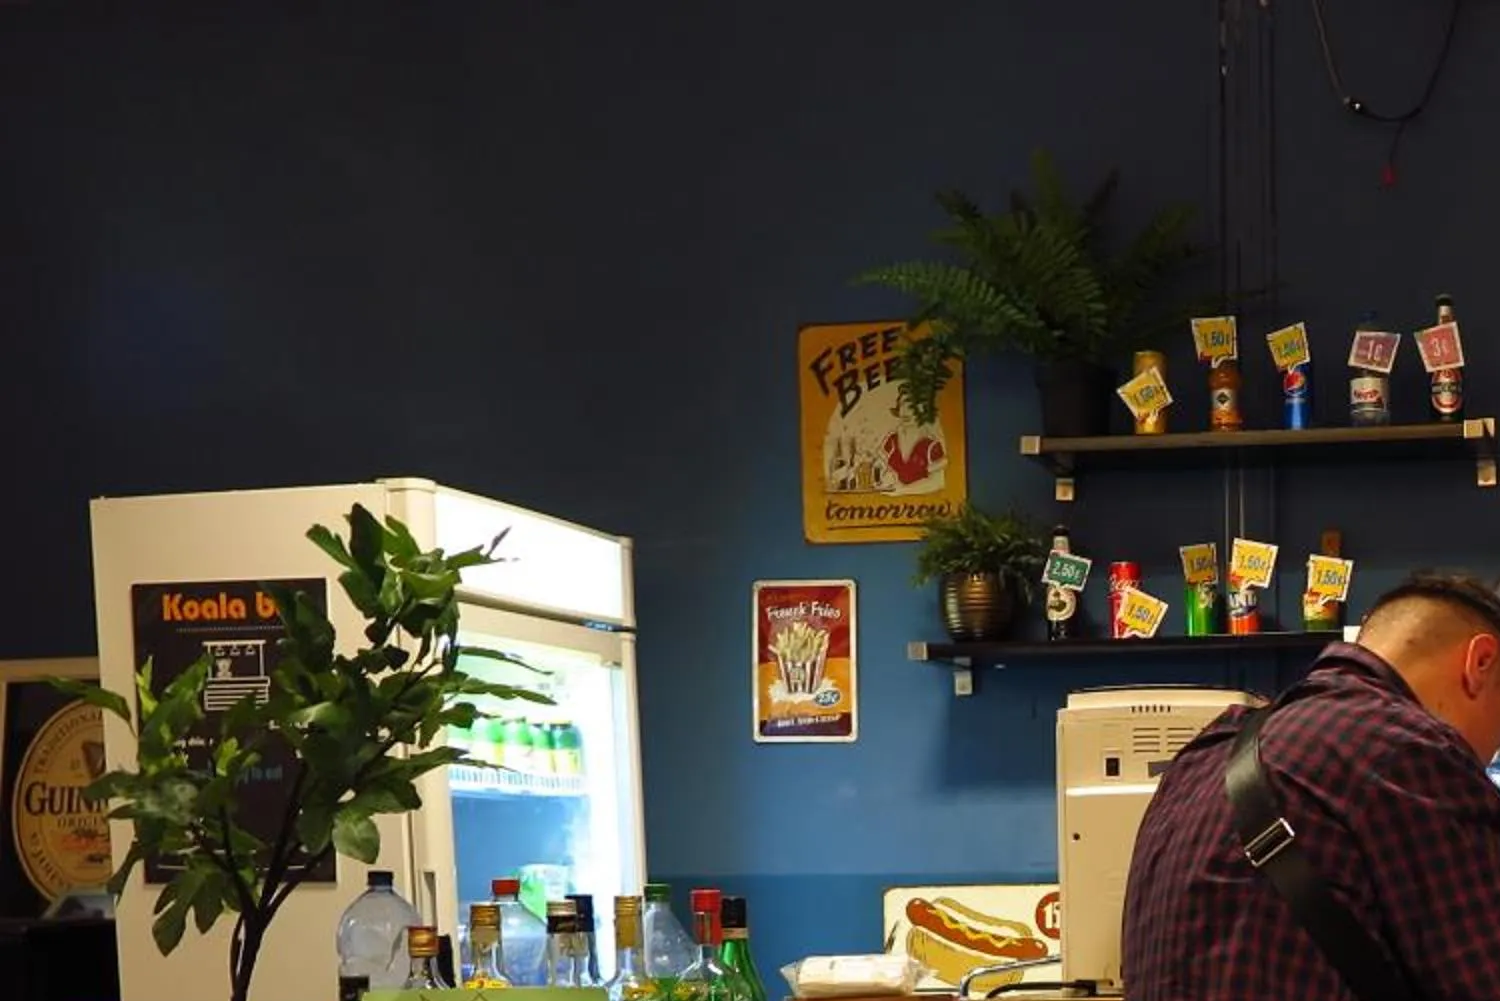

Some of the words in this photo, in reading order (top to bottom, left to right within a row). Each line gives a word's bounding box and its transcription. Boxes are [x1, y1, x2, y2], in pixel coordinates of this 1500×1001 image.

[809, 326, 903, 398] FREE
[833, 354, 952, 420] BEE
[825, 499, 952, 521] tomorrow
[162, 591, 247, 622] Koala
[256, 591, 281, 620] b
